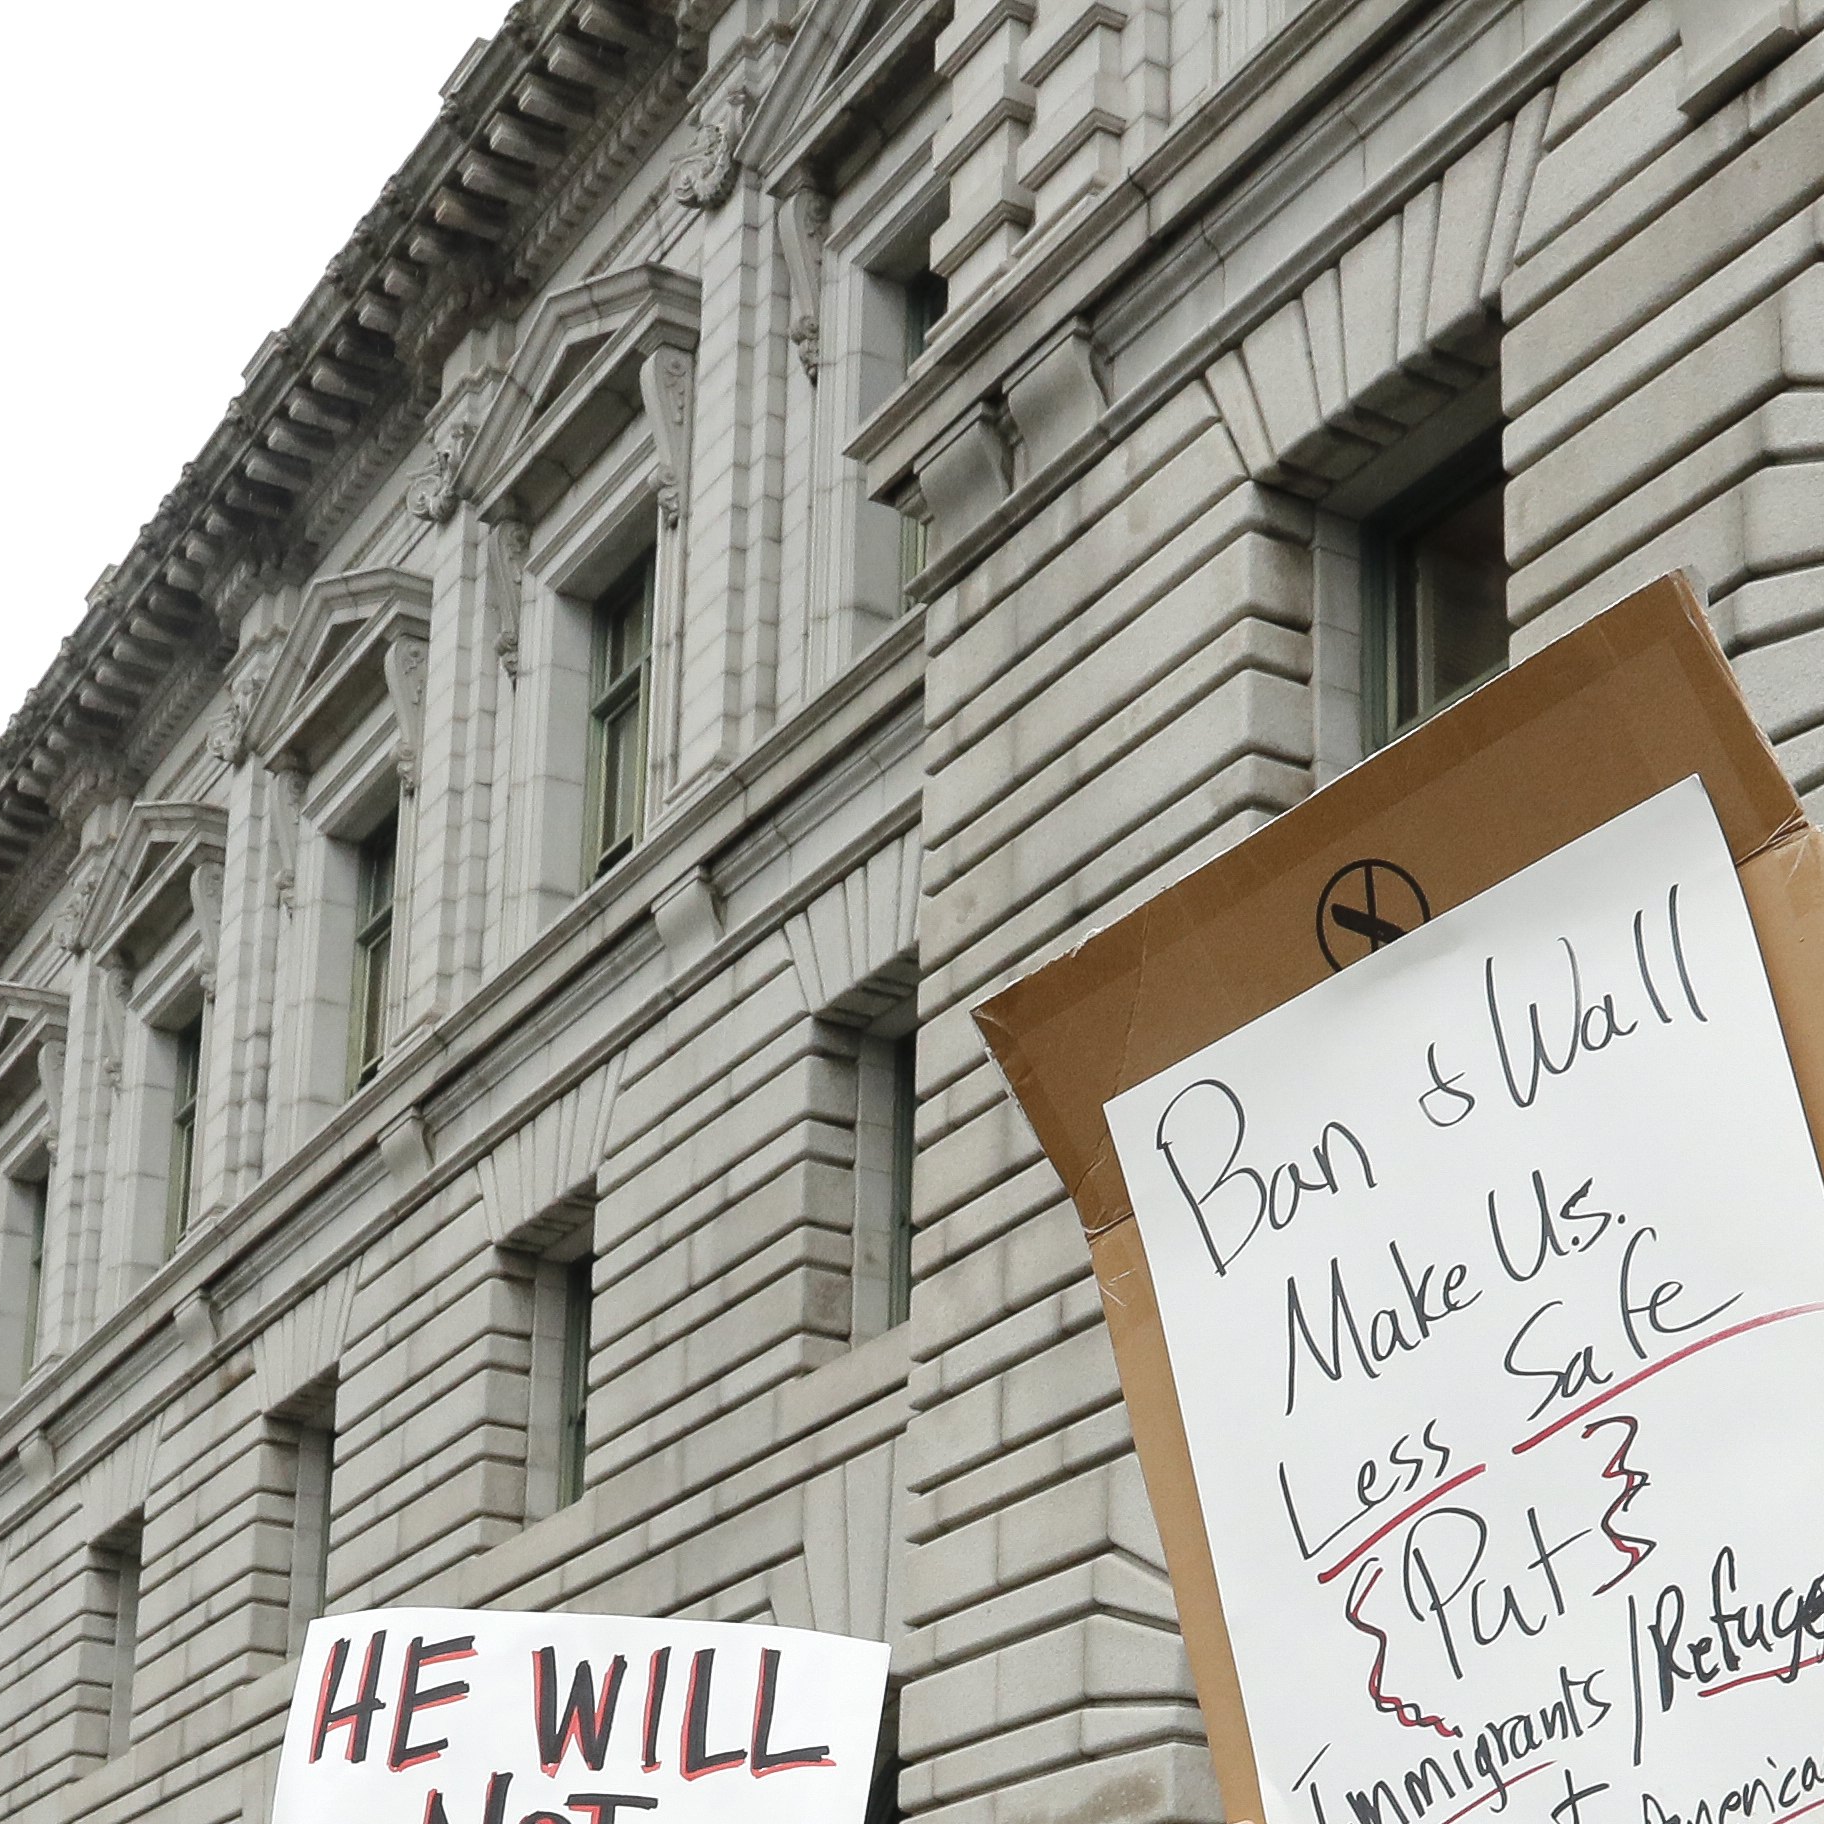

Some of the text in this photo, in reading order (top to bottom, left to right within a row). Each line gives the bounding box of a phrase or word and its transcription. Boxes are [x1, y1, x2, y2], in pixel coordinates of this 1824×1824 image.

[1155, 1079, 1378, 1276] Ban
[1485, 883, 1708, 1108] Wall
[1278, 1226, 1745, 1560] Less Safe
[1285, 1240, 1483, 1416] Make
[309, 1629, 836, 1781] HE WILL
